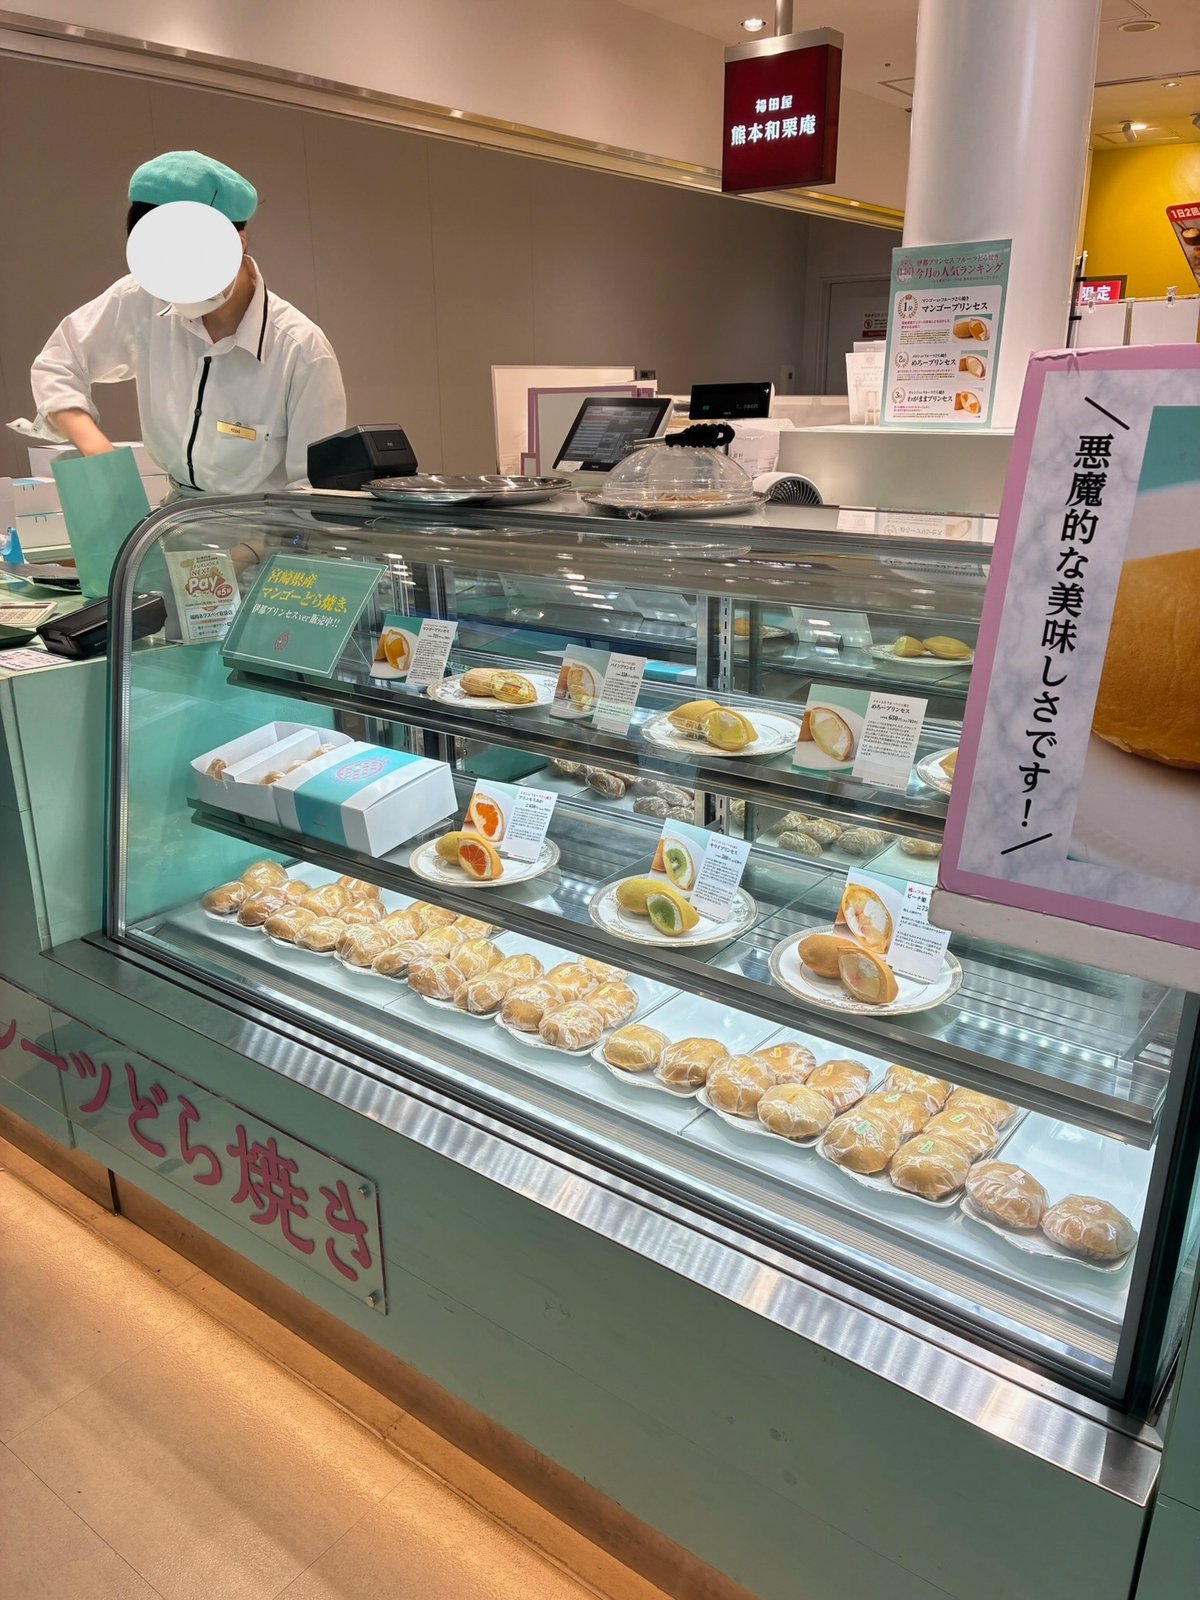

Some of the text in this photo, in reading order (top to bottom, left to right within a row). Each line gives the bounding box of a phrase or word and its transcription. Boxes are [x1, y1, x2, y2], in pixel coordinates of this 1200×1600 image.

[730, 114, 817, 146] 熊本和栗庵
[1170, 206, 1200, 219] 1日2回
[915, 261, 1005, 280] 今月の人気ランキング
[921, 302, 988, 313] マンゴープリンセス
[911, 359, 957, 367] めろープリンセス
[907, 394, 953, 403] わがままプリンセス
[267, 568, 318, 588] 宮崎県産
[261, 587, 348, 613] マンゴーどら焼き
[1018, 432, 1114, 828] 悪魔的な美味しさです！
[871, 704, 910, 714] めろープリンセス
